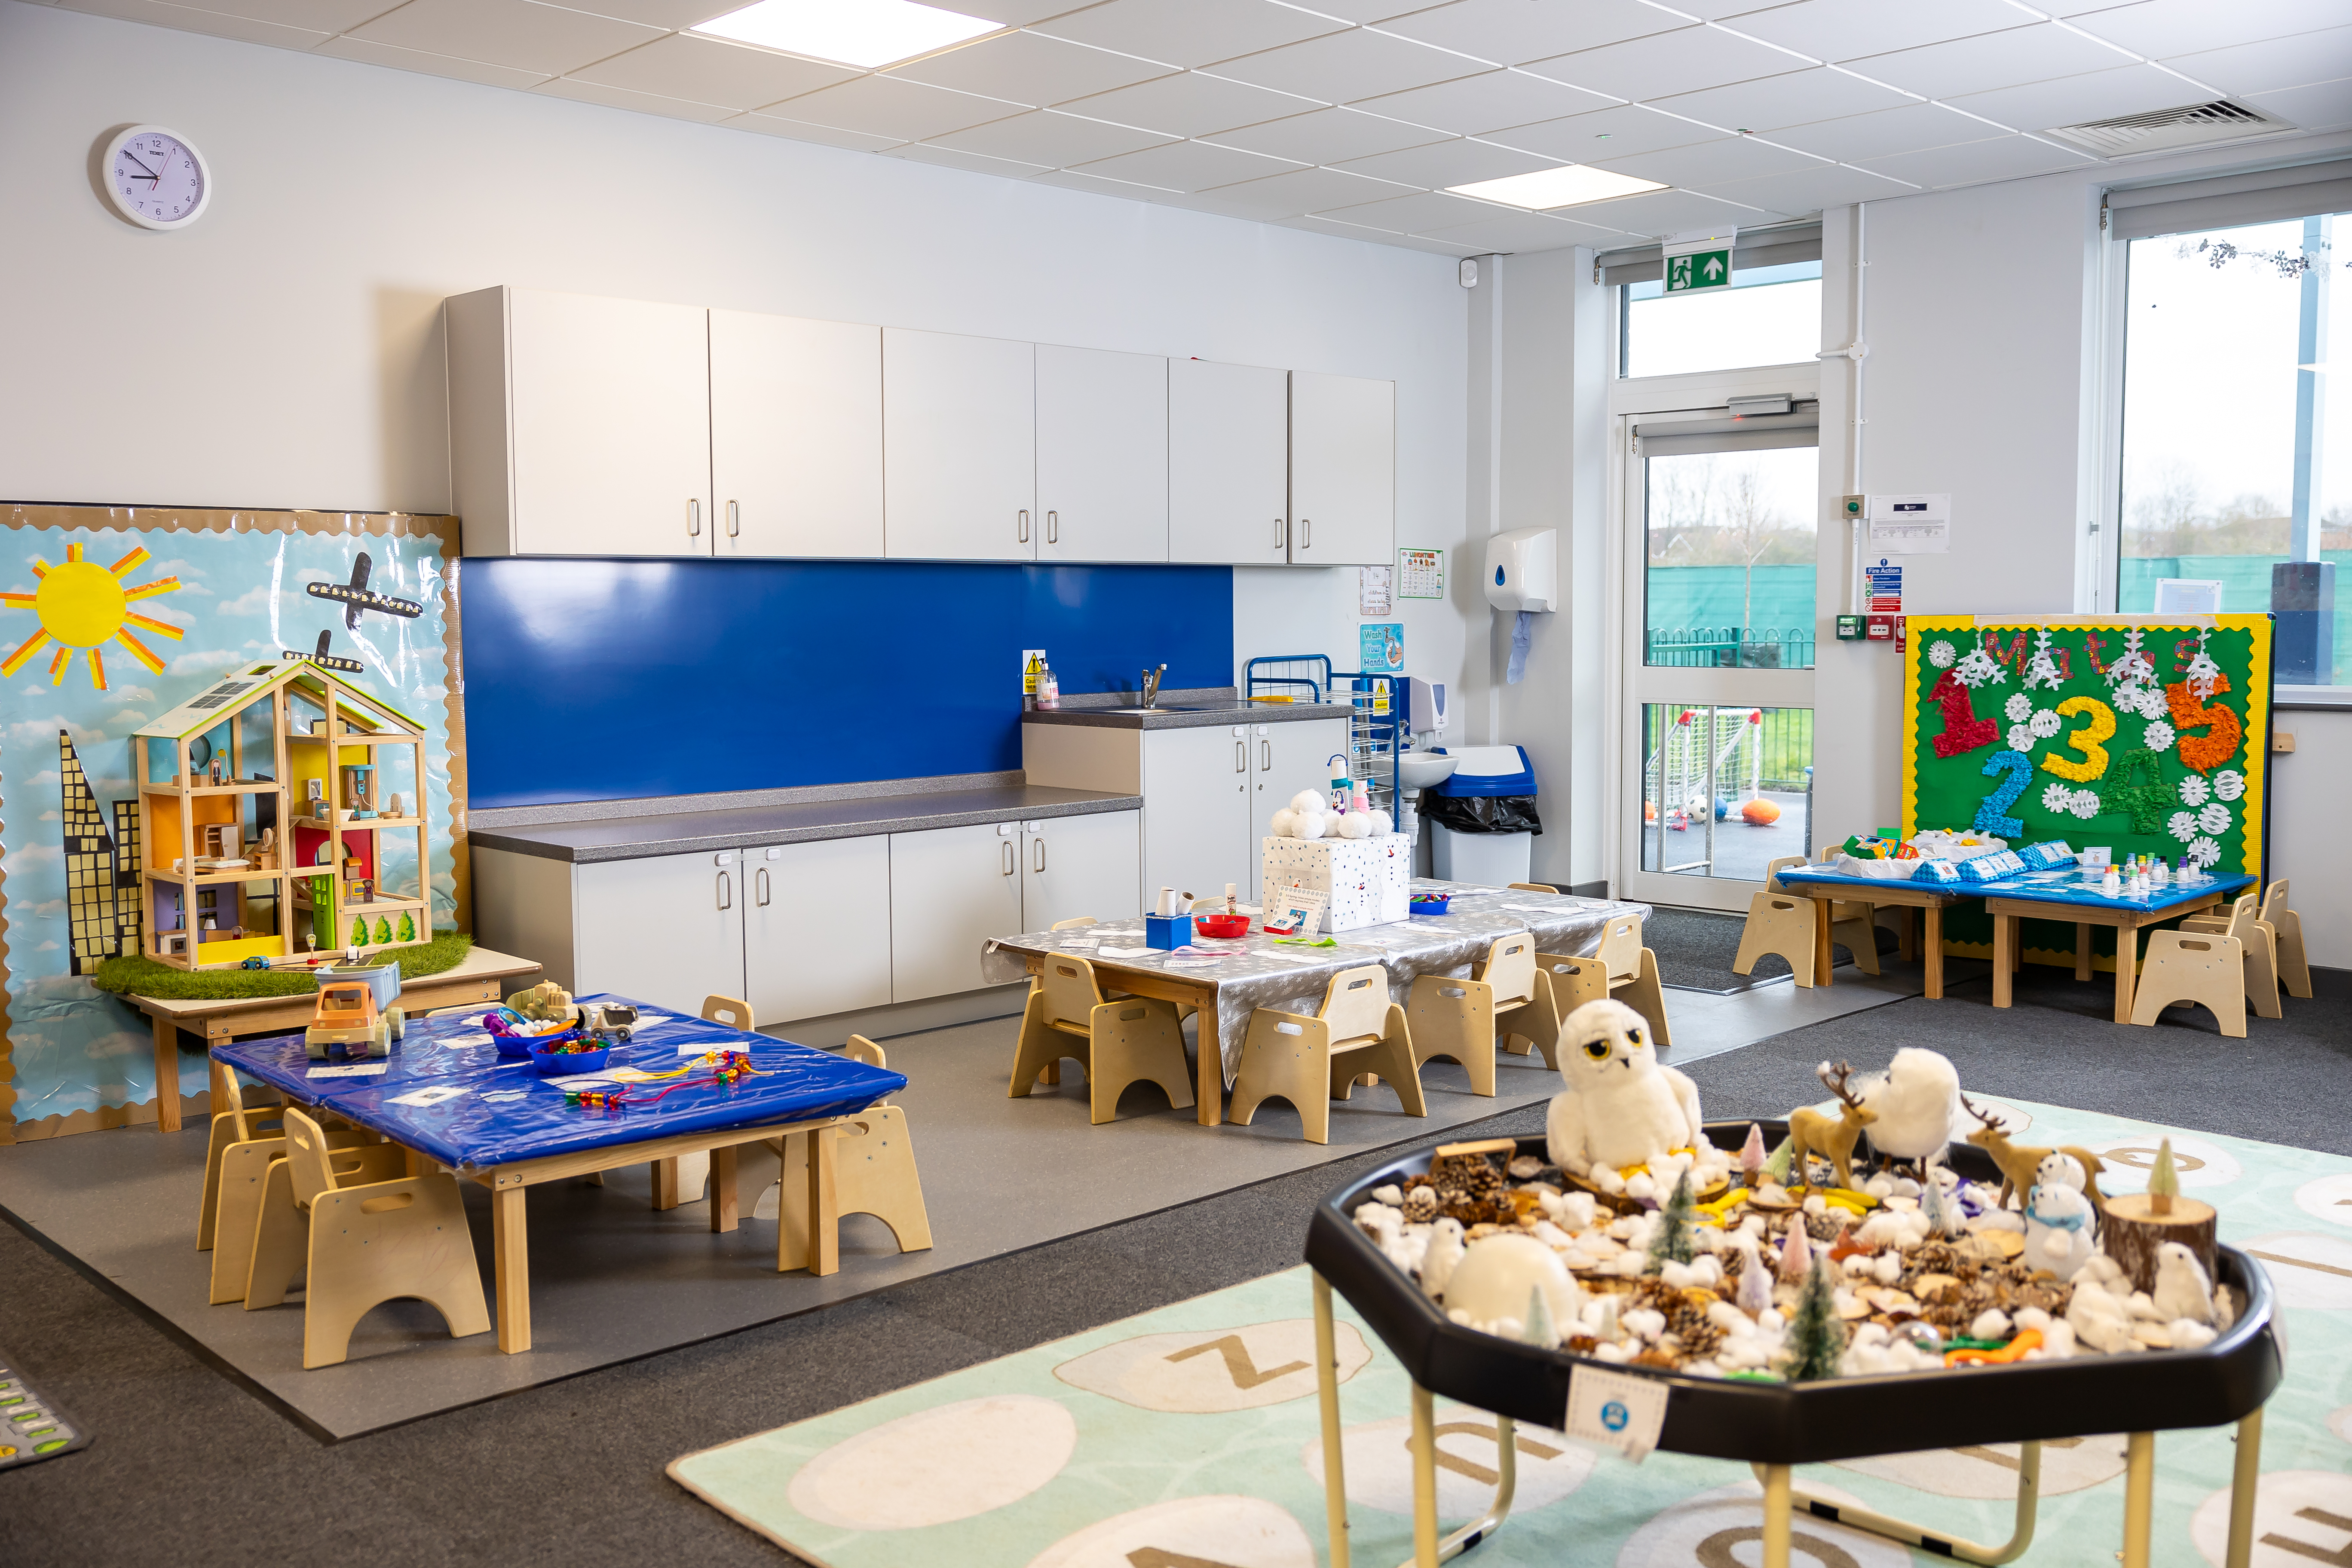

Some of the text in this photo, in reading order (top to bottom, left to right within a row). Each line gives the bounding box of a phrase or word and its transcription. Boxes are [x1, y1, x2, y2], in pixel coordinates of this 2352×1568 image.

[152, 140, 161, 148] 12
[1364, 630, 1382, 639] Wash
[1364, 657, 1384, 667] Hands
[1366, 644, 1381, 653] Your
[1926, 668, 2001, 759] 1
[2040, 695, 2117, 783] 3
[2165, 673, 2243, 778] 5
[1973, 750, 2034, 839] 2
[2098, 747, 2179, 836] 4
